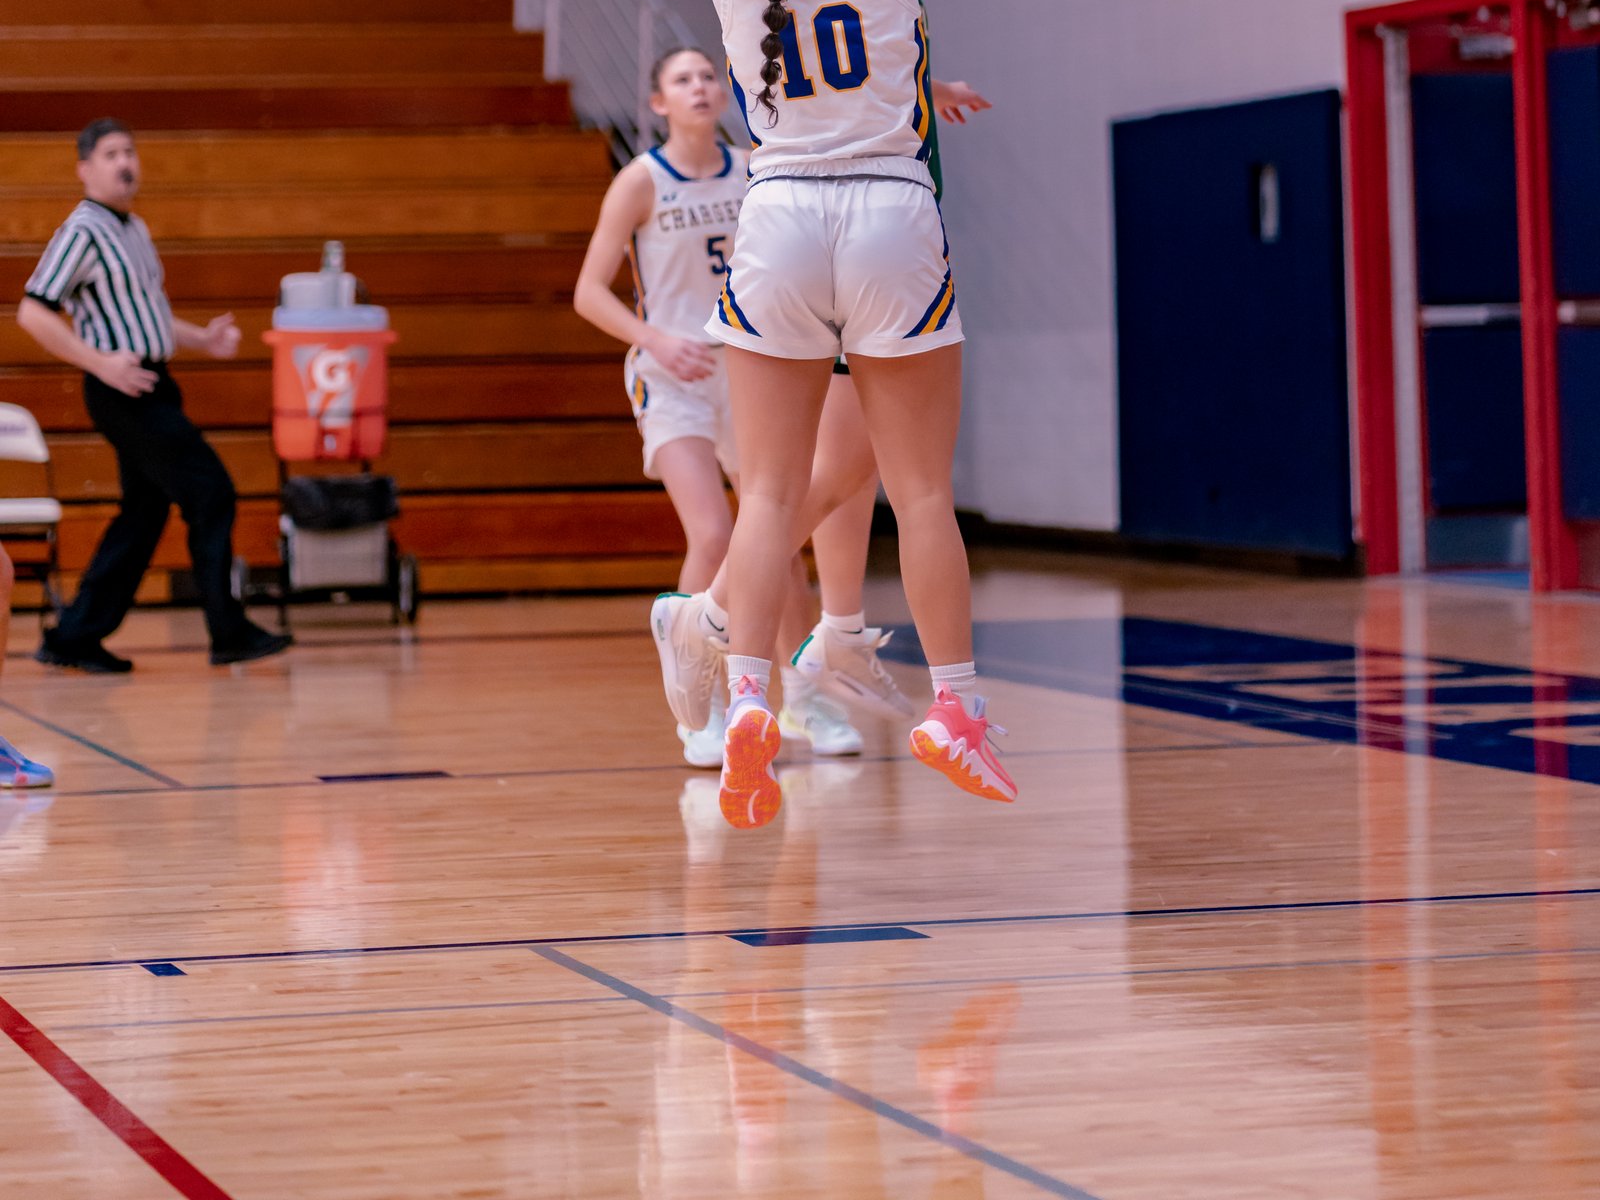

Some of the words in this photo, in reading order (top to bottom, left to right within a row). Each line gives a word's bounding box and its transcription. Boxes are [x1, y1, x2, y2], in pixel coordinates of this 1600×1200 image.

[780, 1, 871, 101] 10
[706, 235, 728, 275] 5
[312, 348, 351, 393] G
